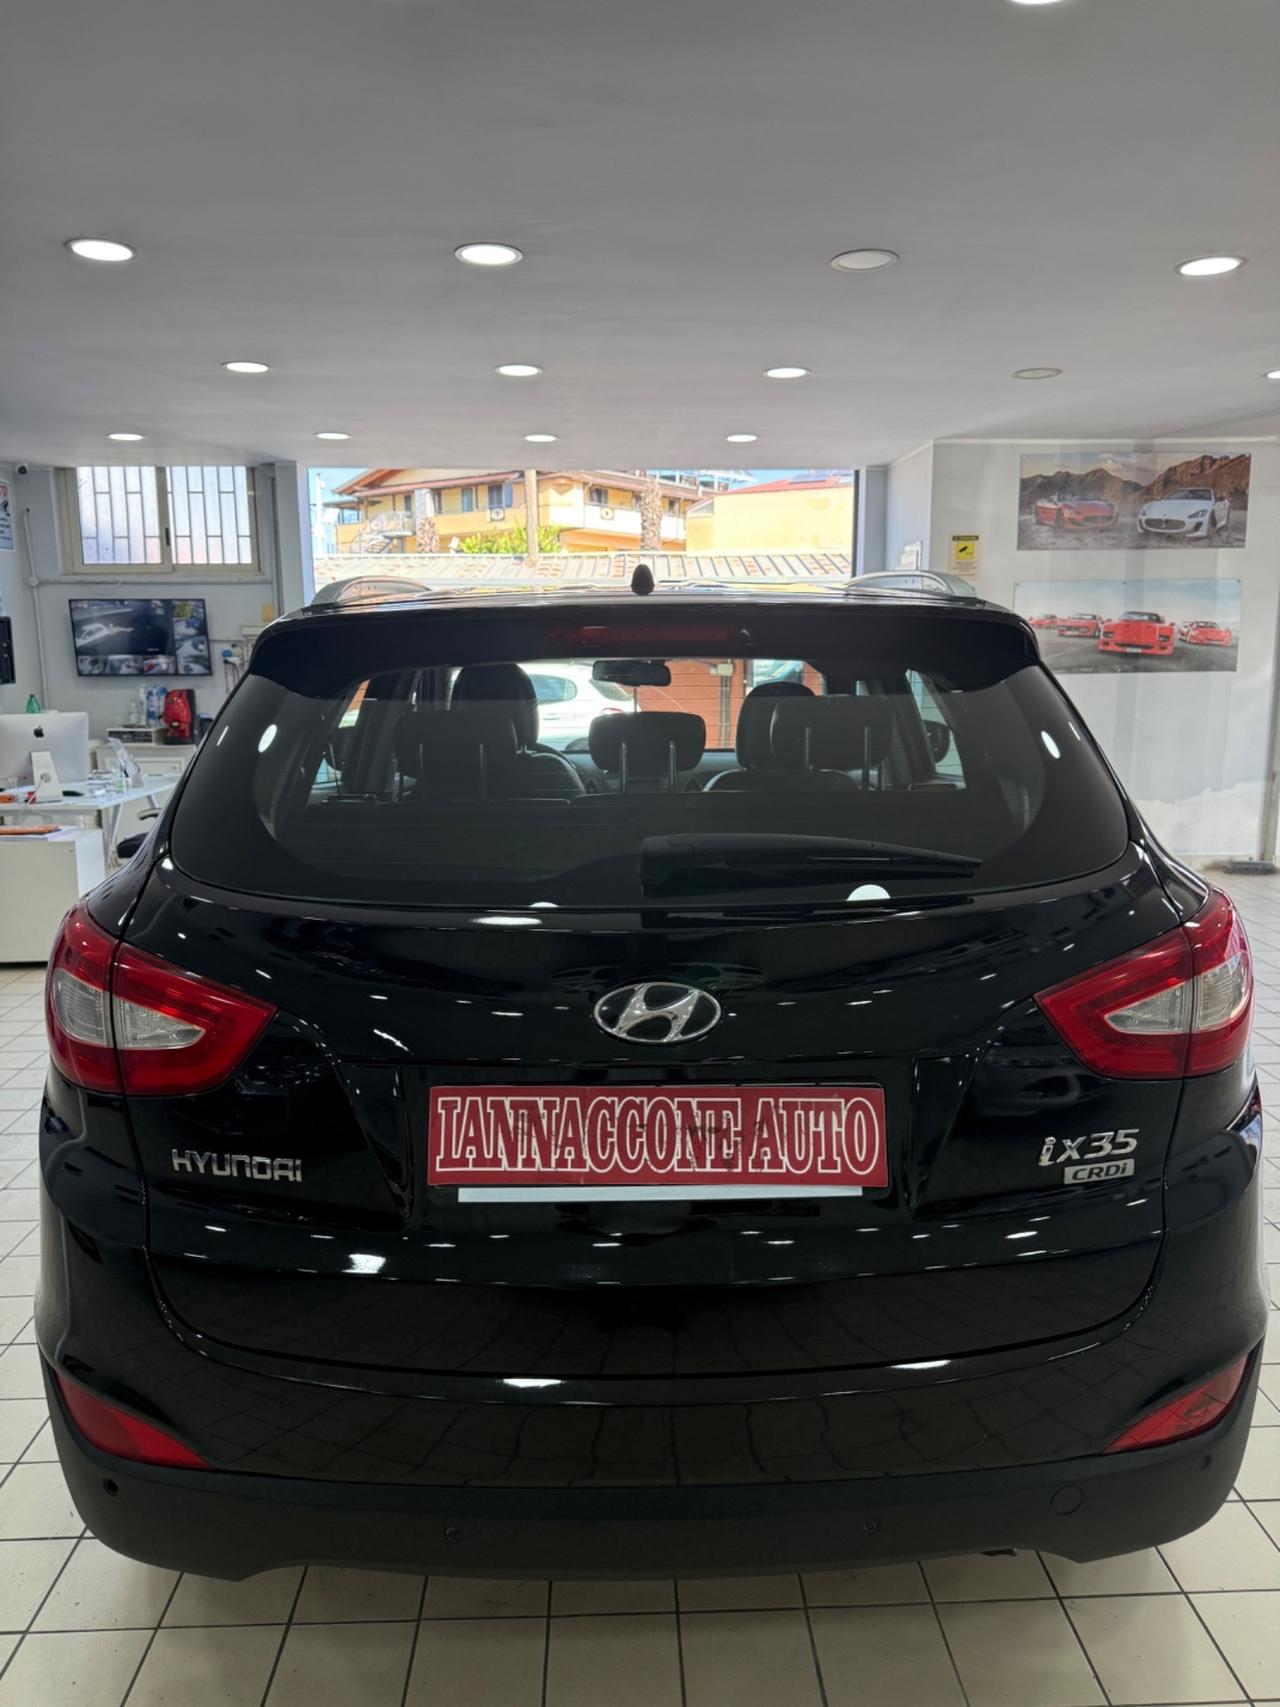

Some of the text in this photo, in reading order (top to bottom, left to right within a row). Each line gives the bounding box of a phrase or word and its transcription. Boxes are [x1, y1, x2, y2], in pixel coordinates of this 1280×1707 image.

[435, 1096, 879, 1175] IANNACCONE AUTO
[171, 1148, 303, 1182] HYUNDAI
